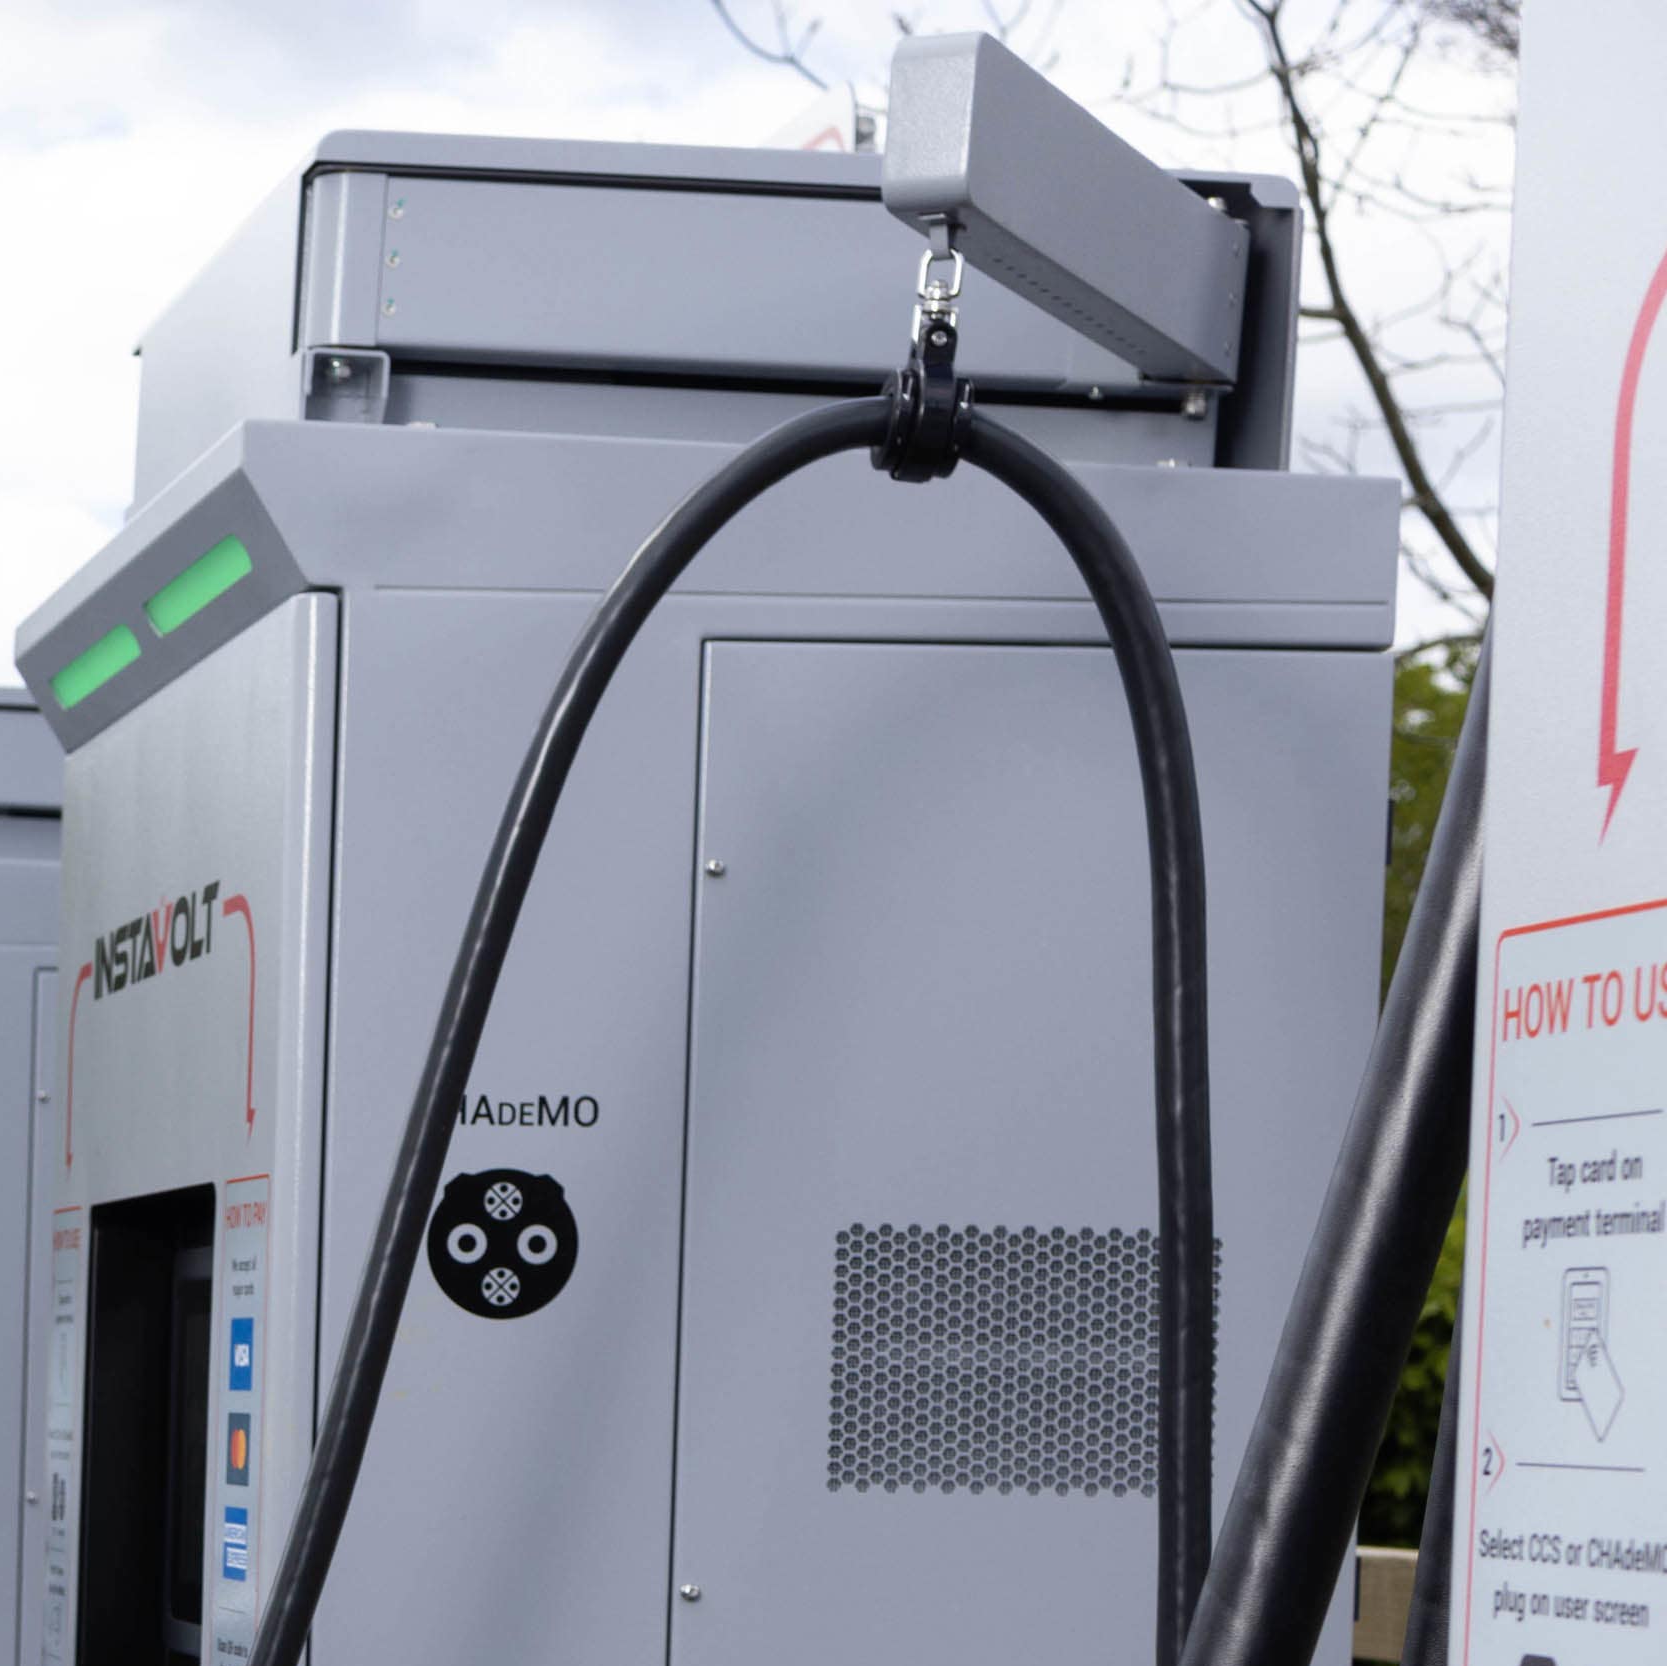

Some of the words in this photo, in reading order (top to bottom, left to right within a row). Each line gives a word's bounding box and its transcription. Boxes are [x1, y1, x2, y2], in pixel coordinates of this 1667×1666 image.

[93, 879, 220, 1001] INSTAVOLT
[1502, 977, 1575, 1042] HOW
[1582, 969, 1624, 1029] TO
[1499, 1113, 1506, 1142] 1
[1547, 1156, 1577, 1195] Tap
[1580, 1149, 1617, 1184] card
[1621, 1156, 1643, 1181] on
[1522, 1209, 1591, 1249] payment
[1595, 1200, 1666, 1238] terminal
[1482, 1447, 1493, 1476] 2
[1478, 1527, 1525, 1562] Select
[1528, 1532, 1562, 1565] CCS
[1566, 1543, 1584, 1566] or
[1493, 1581, 1527, 1622] plug
[1531, 1592, 1550, 1616] on
[1553, 1595, 1590, 1621] user
[1593, 1599, 1650, 1628] screen
